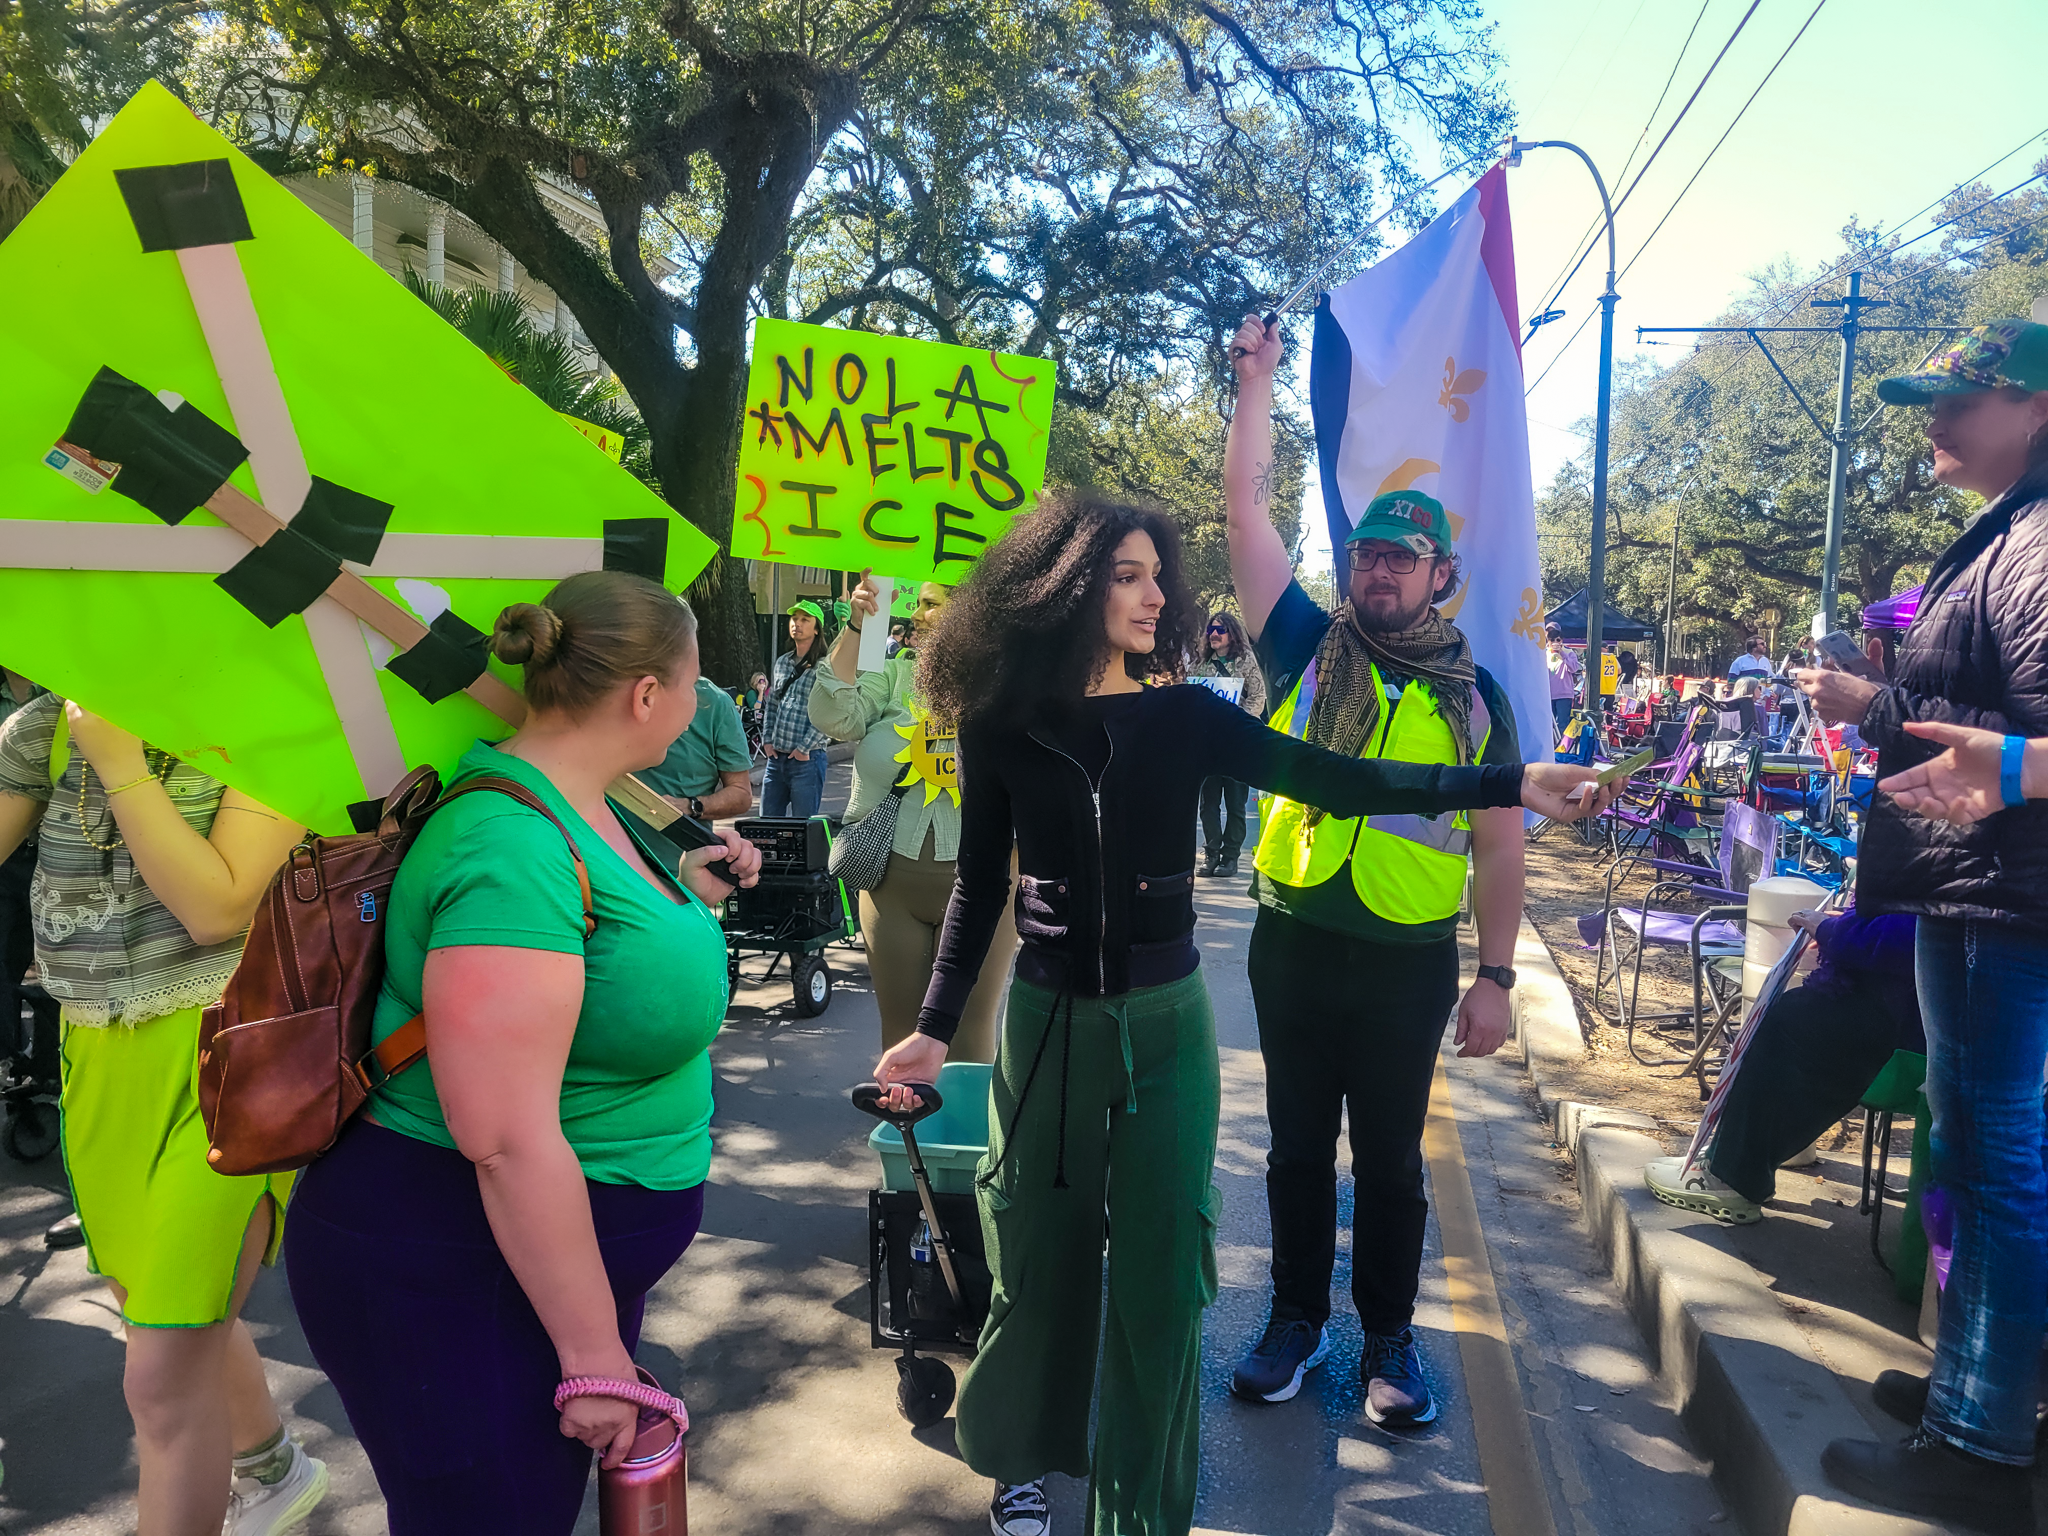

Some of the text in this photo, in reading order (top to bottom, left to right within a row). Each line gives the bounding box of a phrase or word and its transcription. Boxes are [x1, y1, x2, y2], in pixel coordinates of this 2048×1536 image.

[777, 347, 1010, 440] NOLA
[73, 470, 100, 489] POSTER
[784, 407, 1025, 511] MELTS
[780, 480, 987, 573] ICE
[1603, 665, 1615, 676] 23
[936, 757, 956, 775] IC
